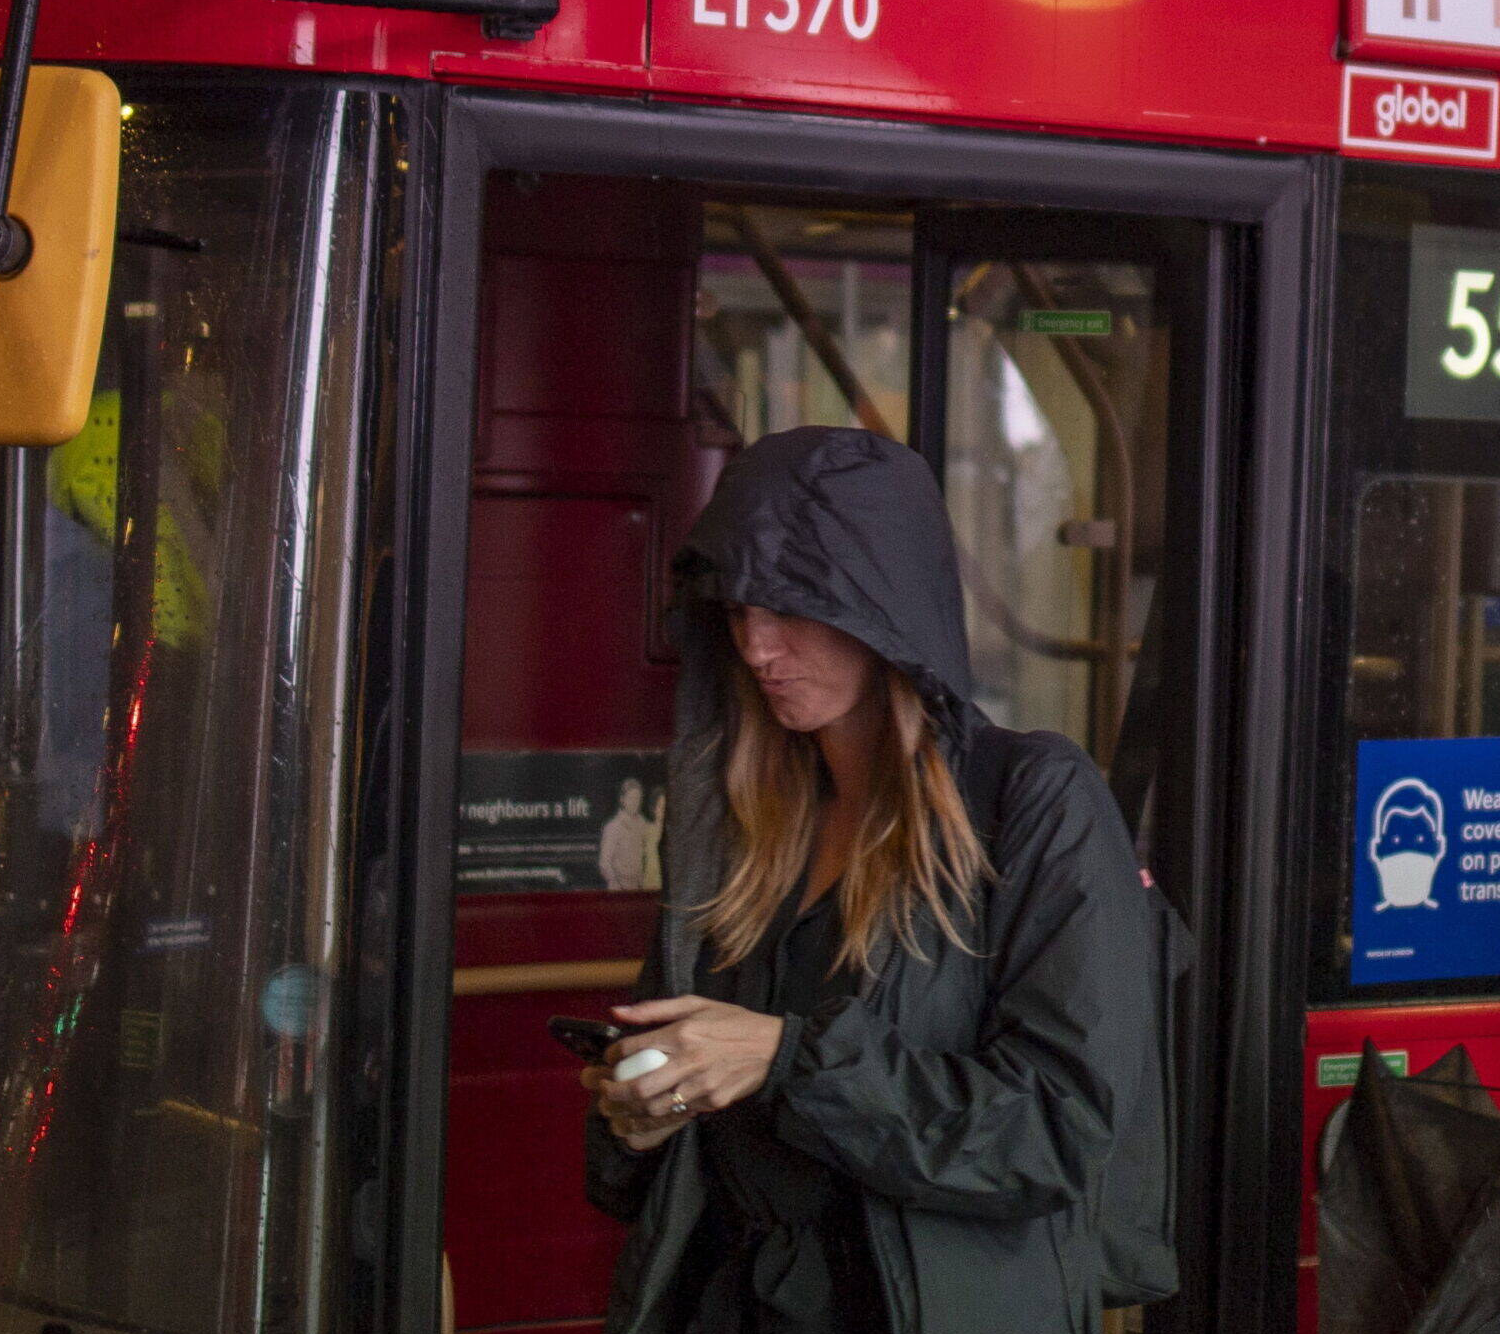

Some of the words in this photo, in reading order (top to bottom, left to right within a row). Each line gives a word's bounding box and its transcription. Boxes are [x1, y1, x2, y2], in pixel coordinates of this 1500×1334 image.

[1374, 84, 1467, 137] global
[467, 796, 550, 824] neighbours
[553, 801, 563, 818] a
[567, 795, 591, 818] lift
[1460, 852, 1485, 871] on
